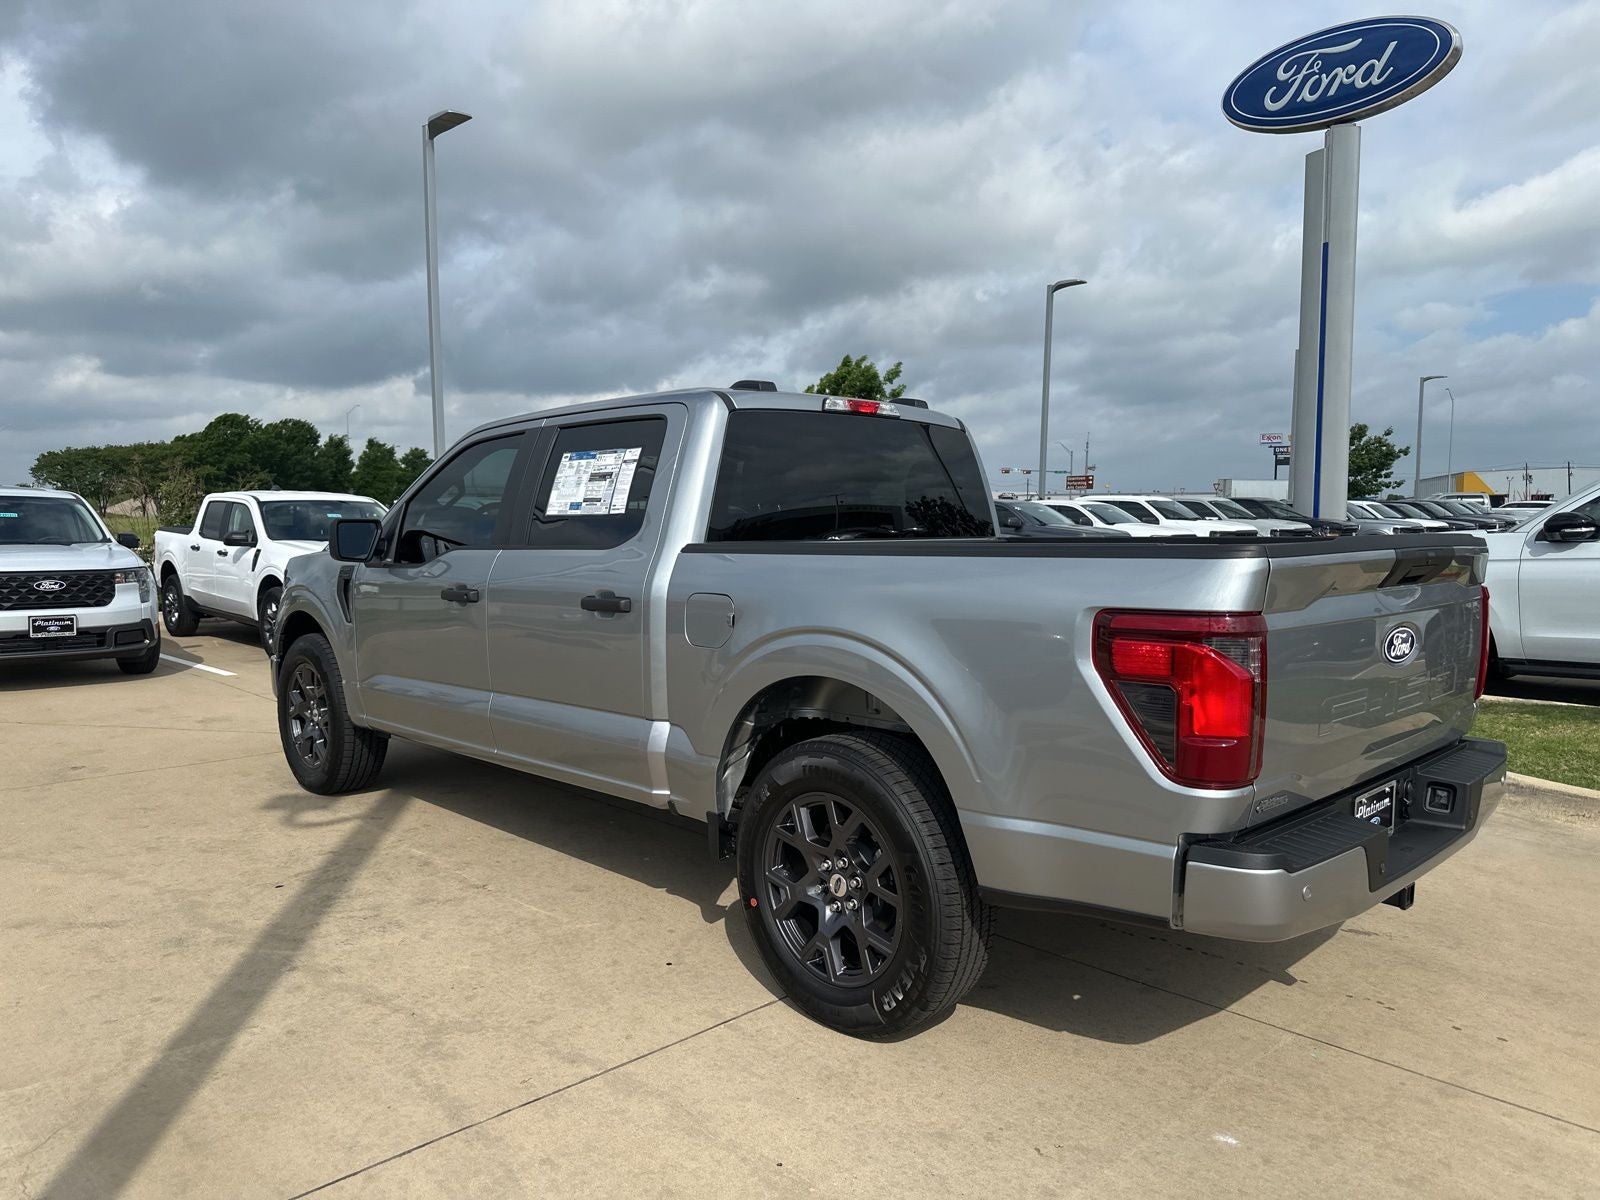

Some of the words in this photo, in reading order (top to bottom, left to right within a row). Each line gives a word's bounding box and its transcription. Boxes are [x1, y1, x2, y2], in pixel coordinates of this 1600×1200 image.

[1263, 38, 1398, 111] Ford
[1261, 434, 1282, 442] Exxon
[40, 581, 60, 589] Ford
[33, 619, 73, 627] Platinum
[1391, 632, 1411, 657] Ford
[1355, 797, 1391, 819] Platinum
